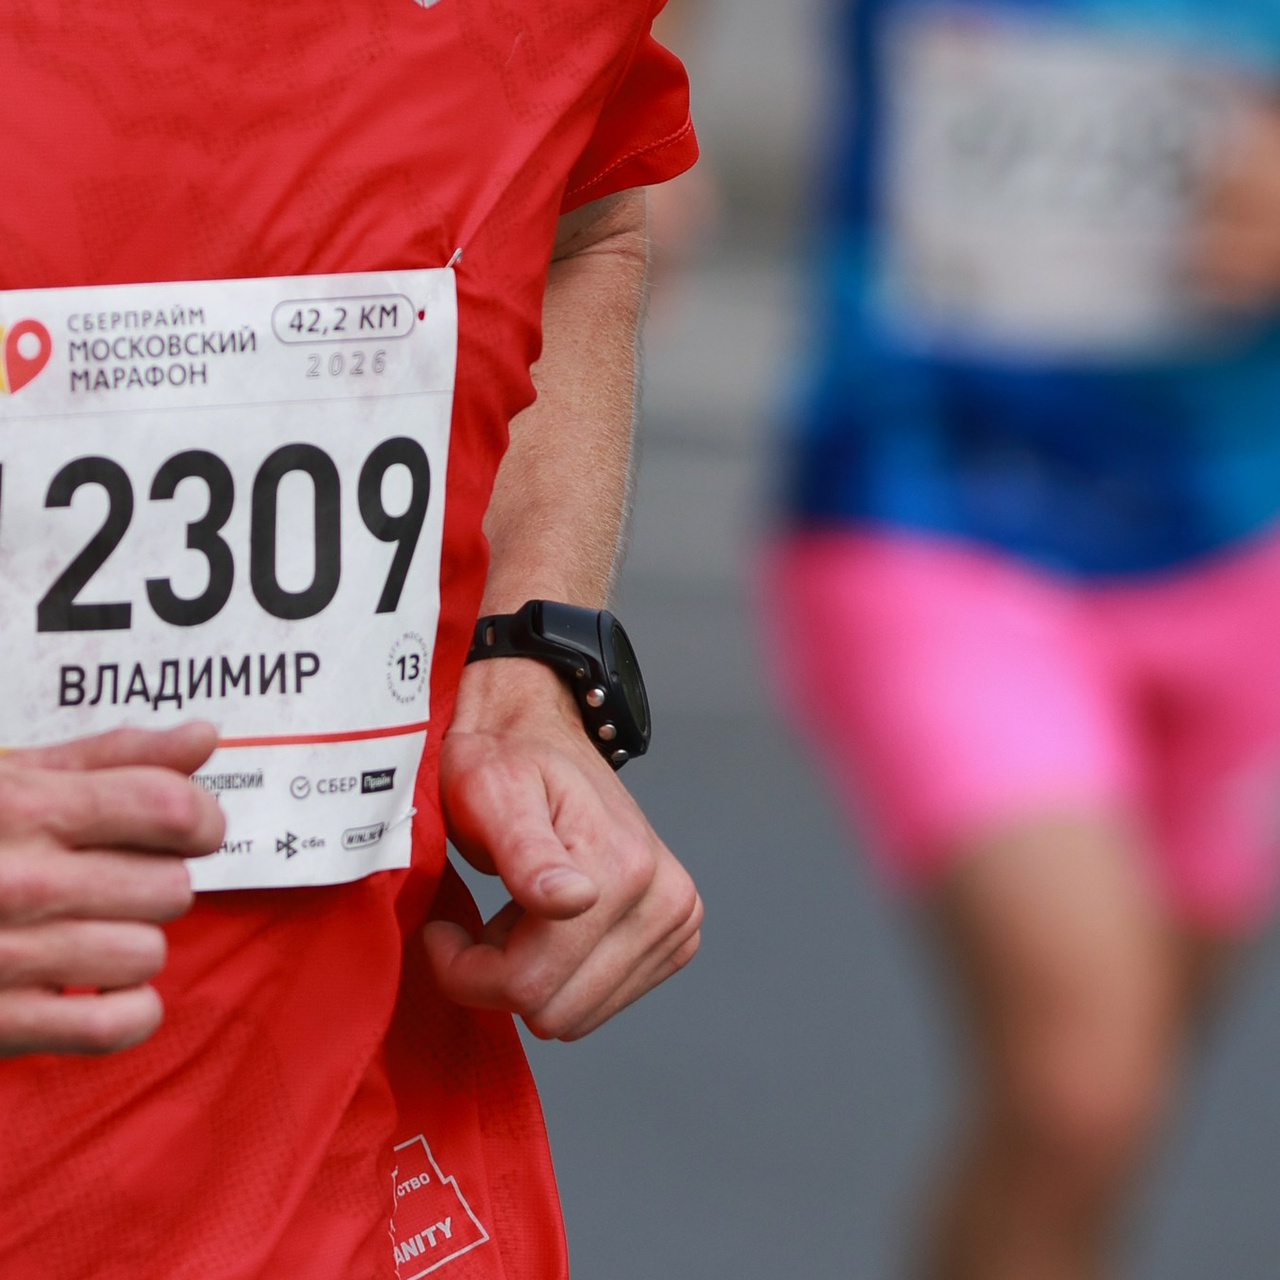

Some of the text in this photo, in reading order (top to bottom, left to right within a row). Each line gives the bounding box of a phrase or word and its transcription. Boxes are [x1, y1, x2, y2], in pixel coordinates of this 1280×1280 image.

[67, 304, 206, 333] СБЕРПРАЙМ
[289, 307, 347, 336] 42,2
[68, 325, 257, 362] МОСКОВСКИЙ
[70, 362, 207, 392] МАРАФОН
[59, 651, 321, 711] ВЛАДИМИР
[397, 654, 420, 681] 13
[191, 768, 264, 791] СКОВСКИЙ
[316, 776, 358, 794] СБЕР
[217, 840, 254, 854] НИТ
[396, 1172, 431, 1198] СТВО
[393, 1217, 452, 1265] ANITY
